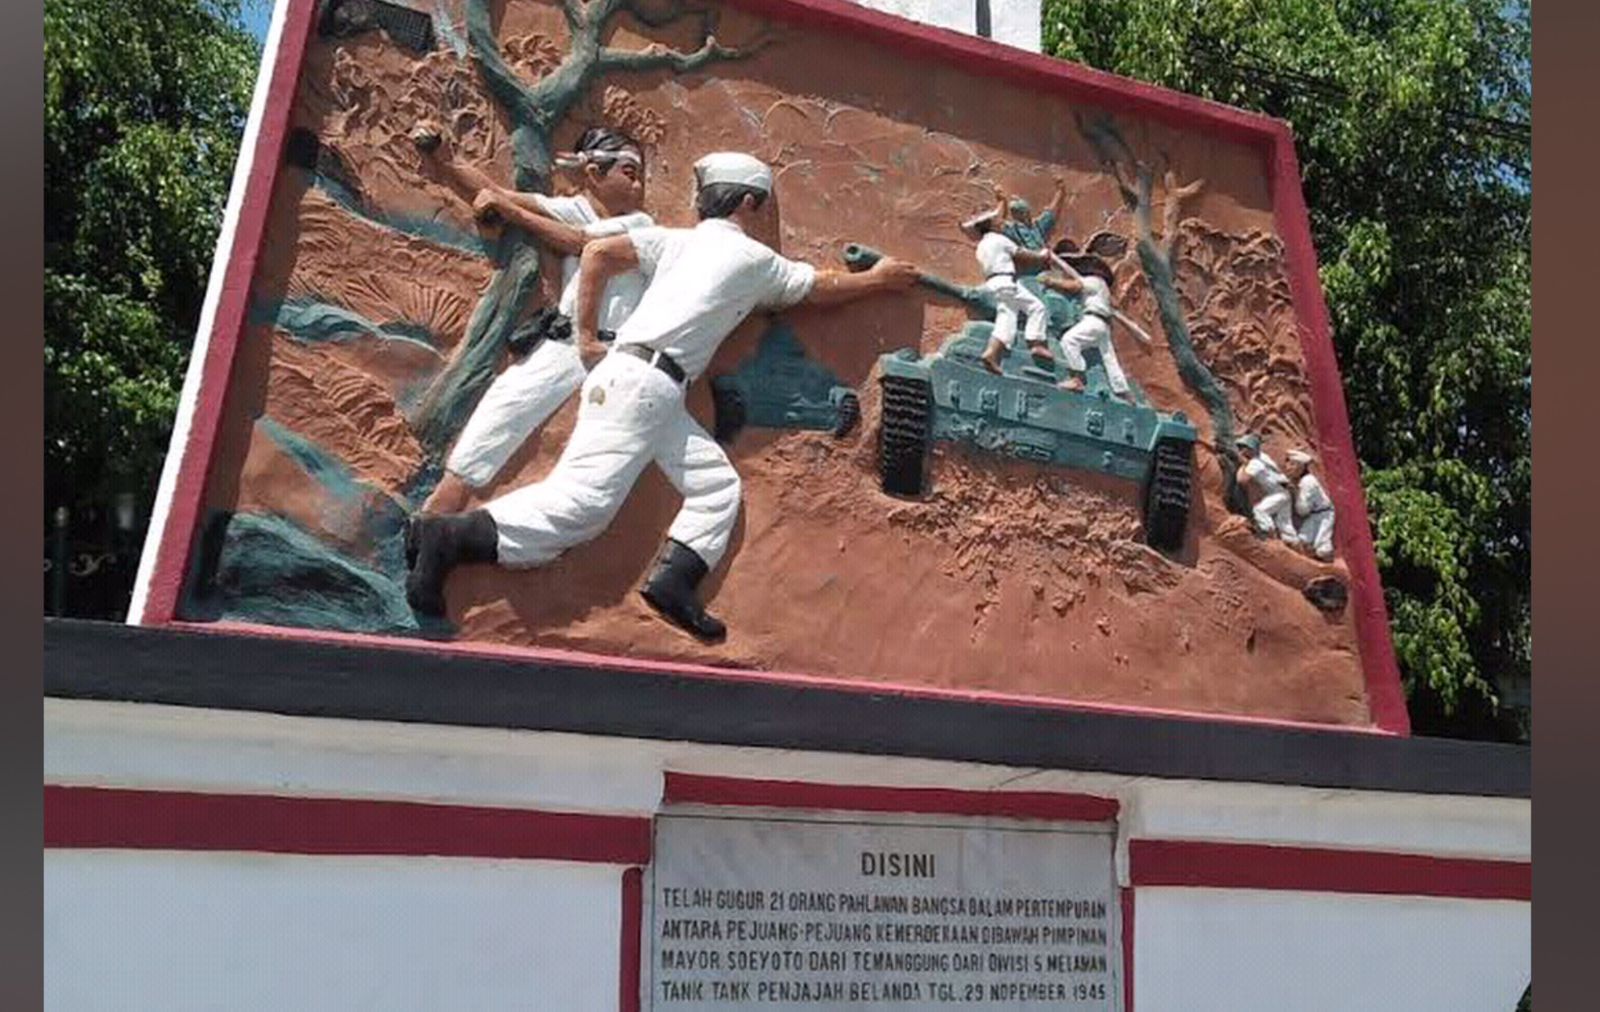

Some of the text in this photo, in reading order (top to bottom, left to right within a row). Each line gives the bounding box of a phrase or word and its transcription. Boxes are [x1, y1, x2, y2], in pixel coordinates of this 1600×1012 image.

[862, 852, 935, 878] DISINI
[663, 887, 712, 908] TELAH
[717, 890, 765, 910] GUGUR
[770, 891, 784, 911] 21
[789, 892, 835, 912] ORANG
[840, 893, 908, 915] PAHLAWAN
[912, 896, 969, 917] BANGSA
[1017, 899, 1106, 919] PERTEMPURAN
[662, 920, 722, 940] ANTARA
[877, 924, 978, 944] KEMERDEKAAN
[982, 926, 1038, 945] DIBAWAH
[1043, 926, 1107, 945] PIMPINAN
[662, 950, 720, 970] MAYOR
[728, 951, 801, 971] SOEYOTO
[809, 951, 846, 971] DARI
[854, 952, 949, 972] TEMANGGUNG
[953, 953, 984, 972] DARI
[989, 953, 1028, 972] DIVISI
[1047, 954, 1107, 973] MELAWAN
[662, 980, 703, 1001] TANK
[713, 981, 750, 1001] TANK
[758, 981, 844, 1001] PENJAJAH
[851, 982, 921, 1001] BELANDA
[990, 984, 1066, 1001] NOPEMBER
[1073, 984, 1105, 1001] 1945
